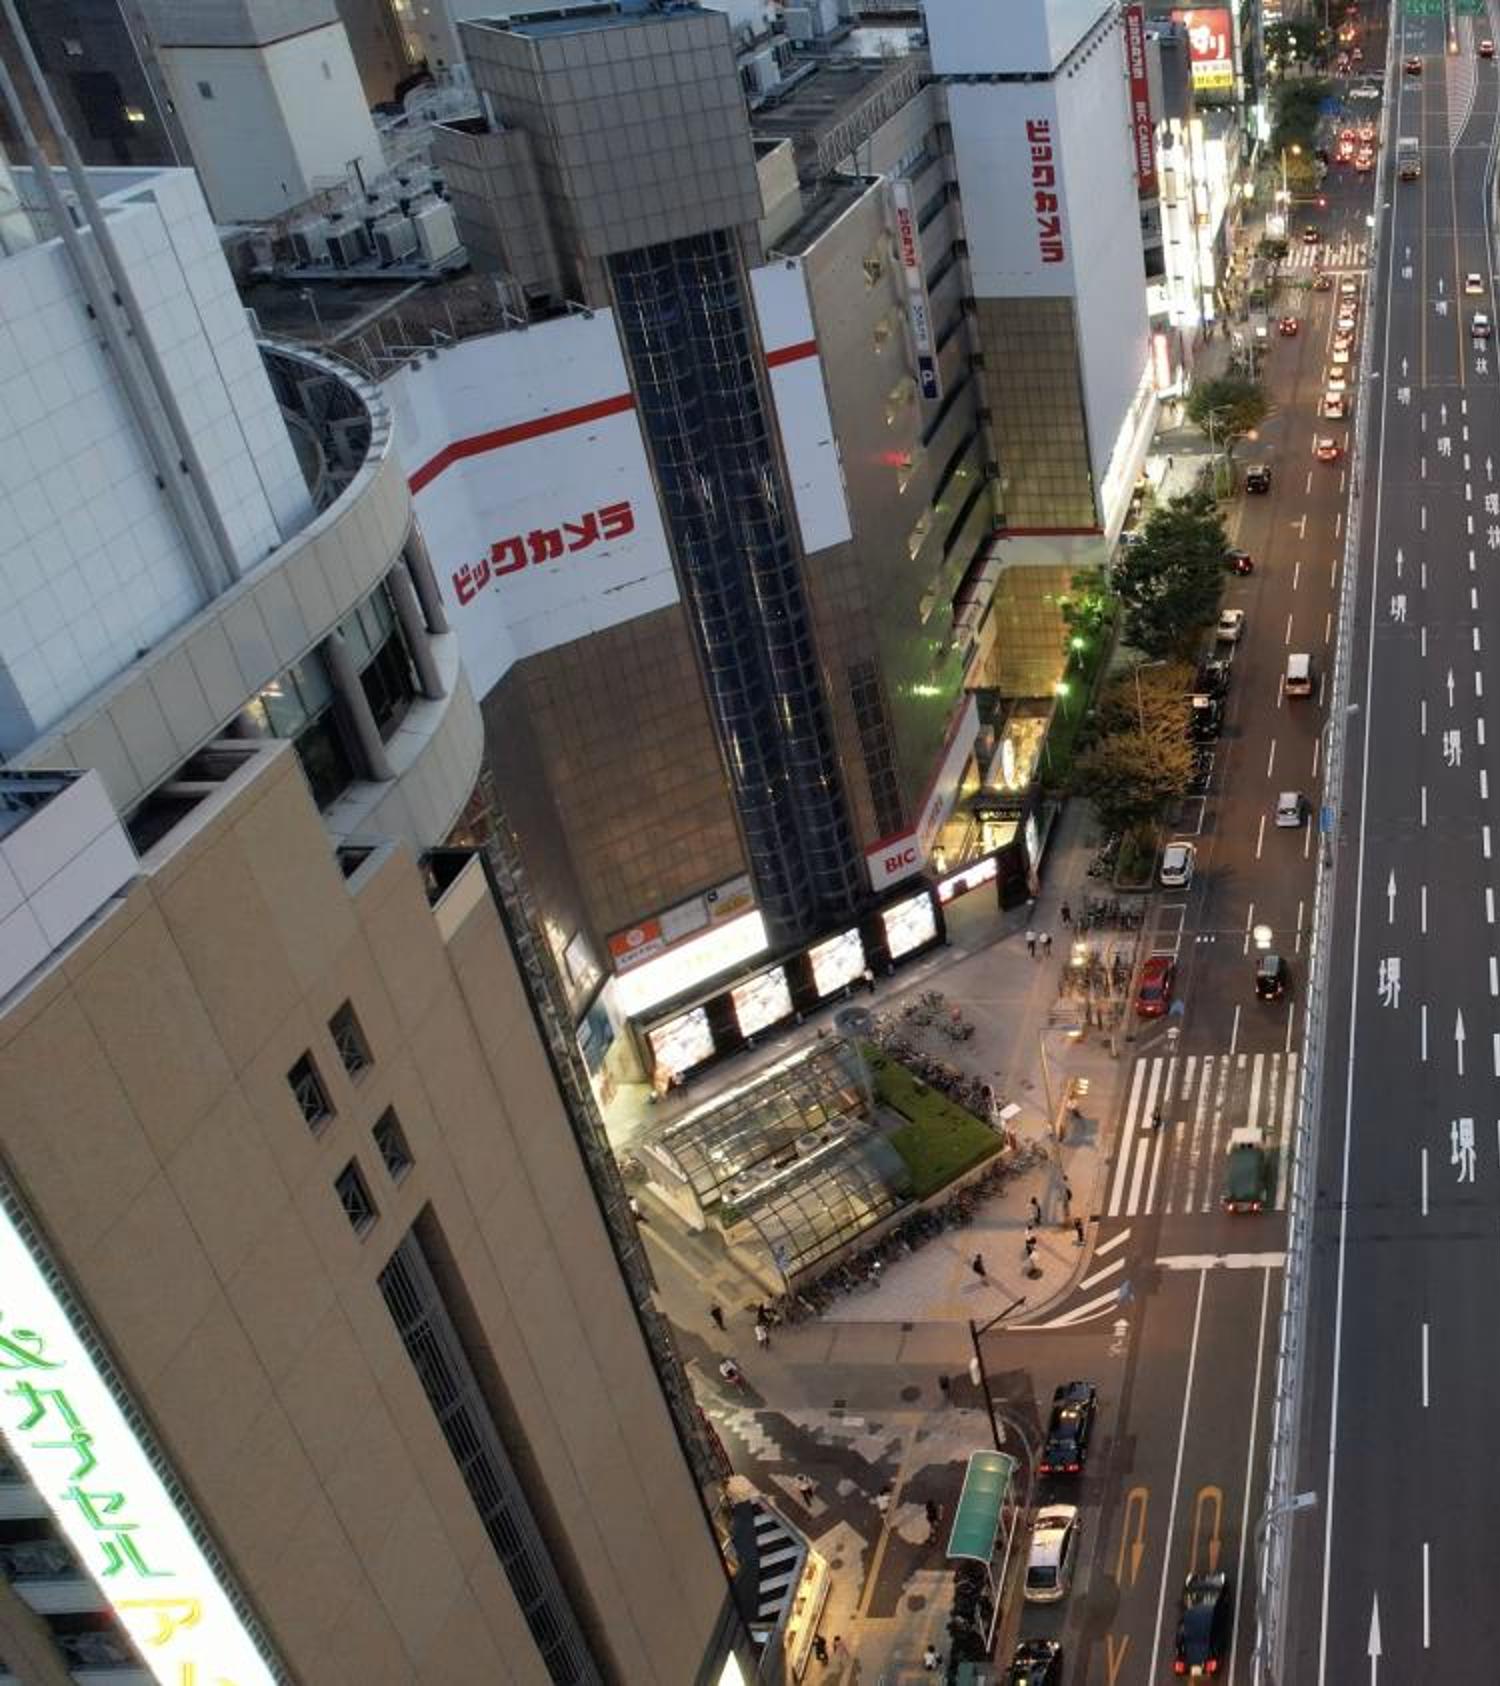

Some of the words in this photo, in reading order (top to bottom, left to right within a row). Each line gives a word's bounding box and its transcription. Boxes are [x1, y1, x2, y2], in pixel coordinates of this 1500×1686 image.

[1137, 126, 1152, 177] CAMERA
[1026, 120, 1064, 262] ビックカメラ
[452, 501, 635, 606] ビックカメラ
[1443, 730, 1462, 767] 堺
[884, 848, 916, 874] BIC
[1378, 957, 1401, 1009] 堺
[1450, 1117, 1477, 1183] 堺
